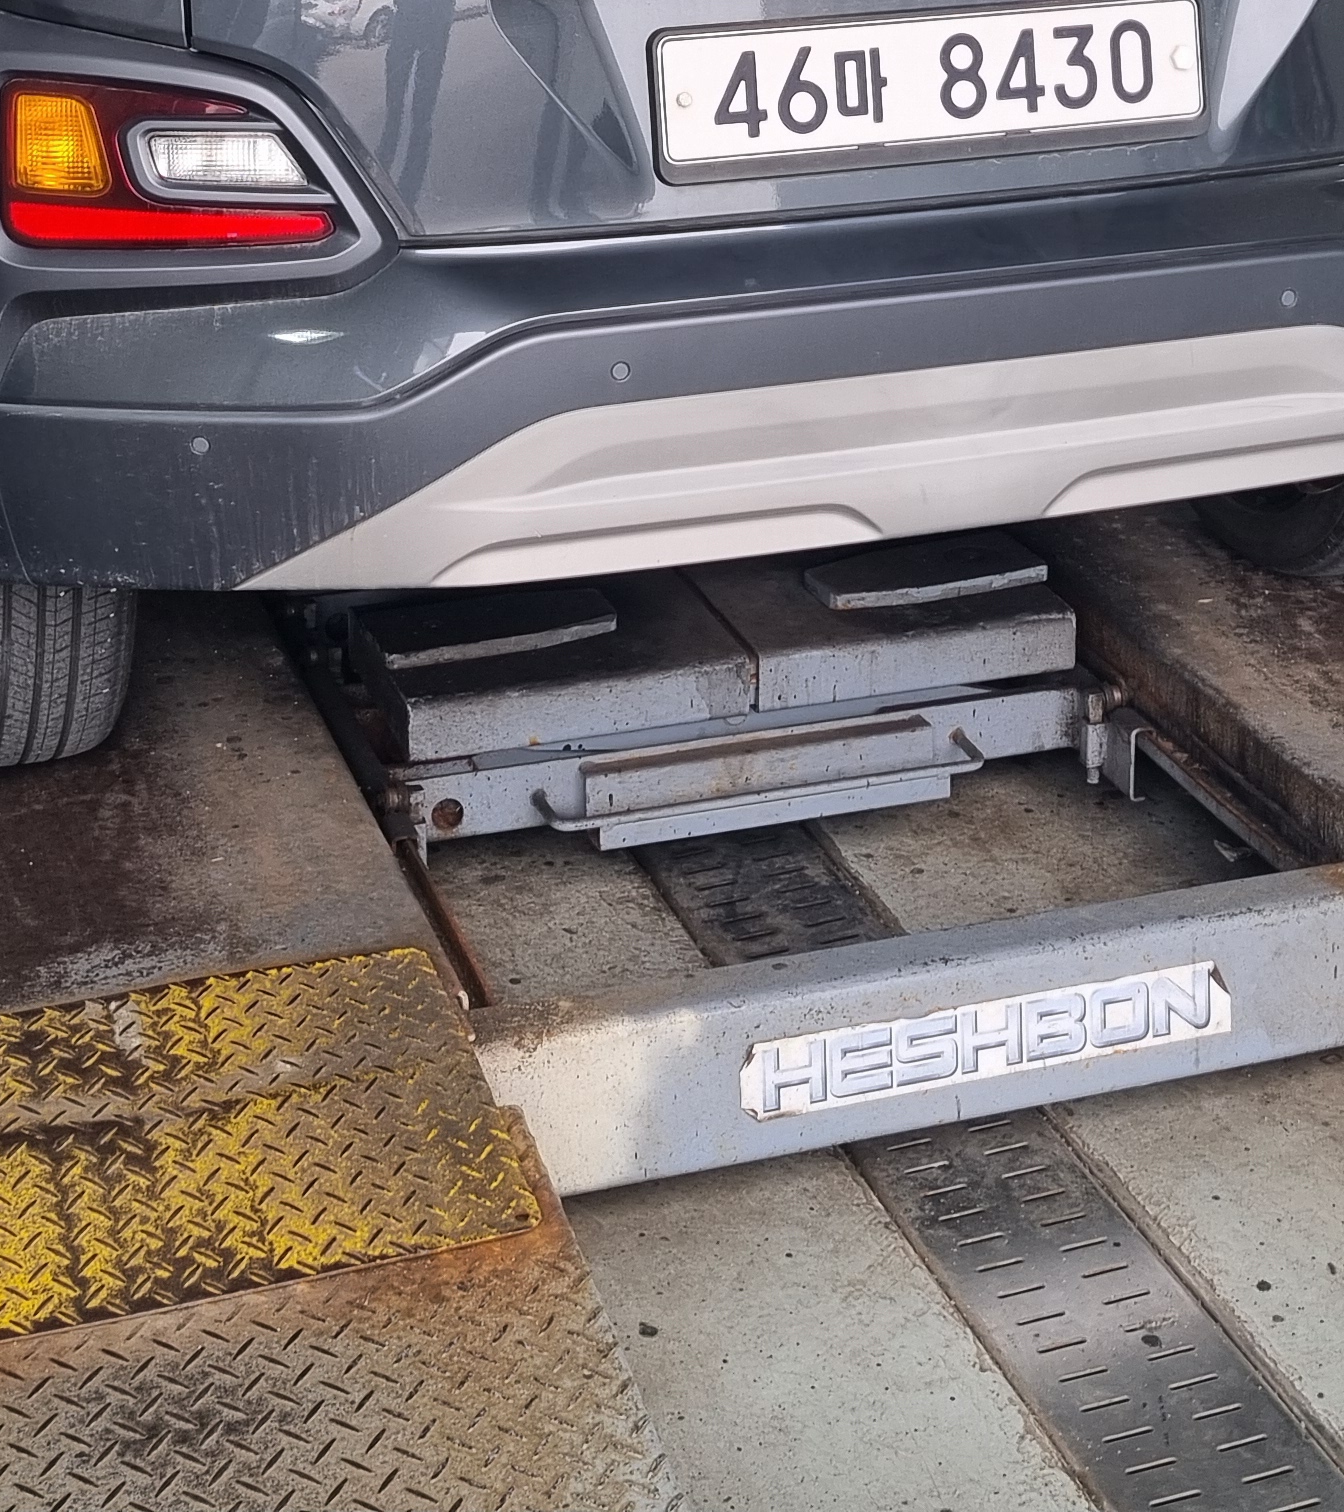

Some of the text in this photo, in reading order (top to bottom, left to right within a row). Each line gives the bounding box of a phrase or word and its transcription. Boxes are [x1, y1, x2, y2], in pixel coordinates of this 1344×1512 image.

[714, 18, 1154, 138] 46마 8430
[760, 966, 1212, 1113] HESHBON
